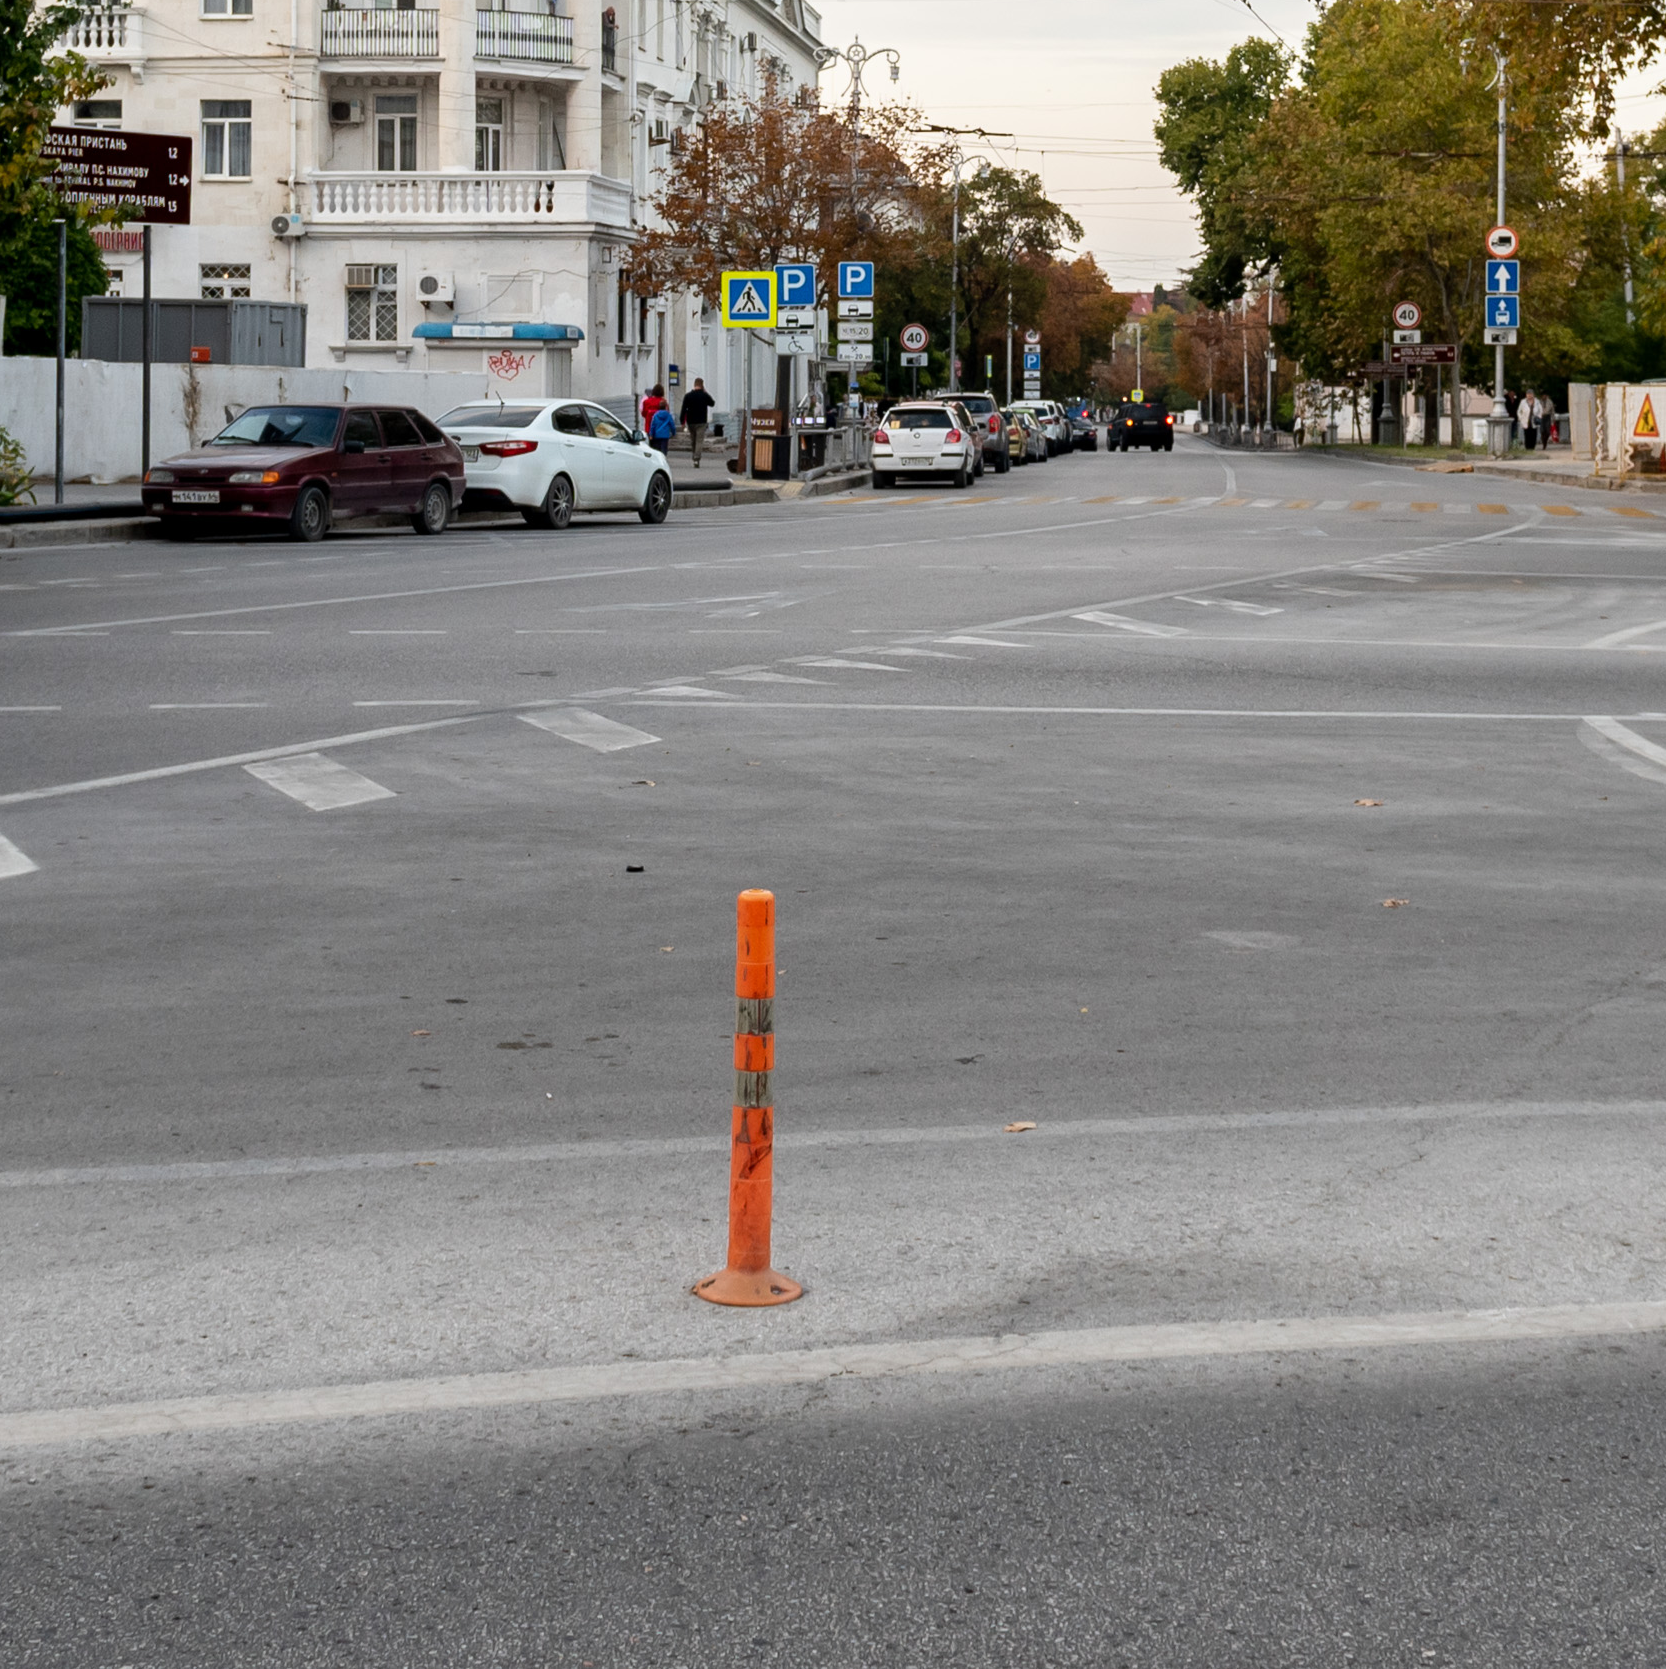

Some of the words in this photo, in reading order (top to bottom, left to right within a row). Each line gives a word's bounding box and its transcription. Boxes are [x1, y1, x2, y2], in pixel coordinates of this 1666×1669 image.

[44, 133, 78, 147] ФСКАЯ
[80, 135, 128, 151] ПРИСТАНЬ
[39, 145, 66, 156] SKAYA
[107, 165, 149, 179] НАХИМОВУ
[783, 269, 806, 302] P
[846, 265, 866, 293] P
[1399, 310, 1414, 320] 40
[906, 332, 922, 343] 40
